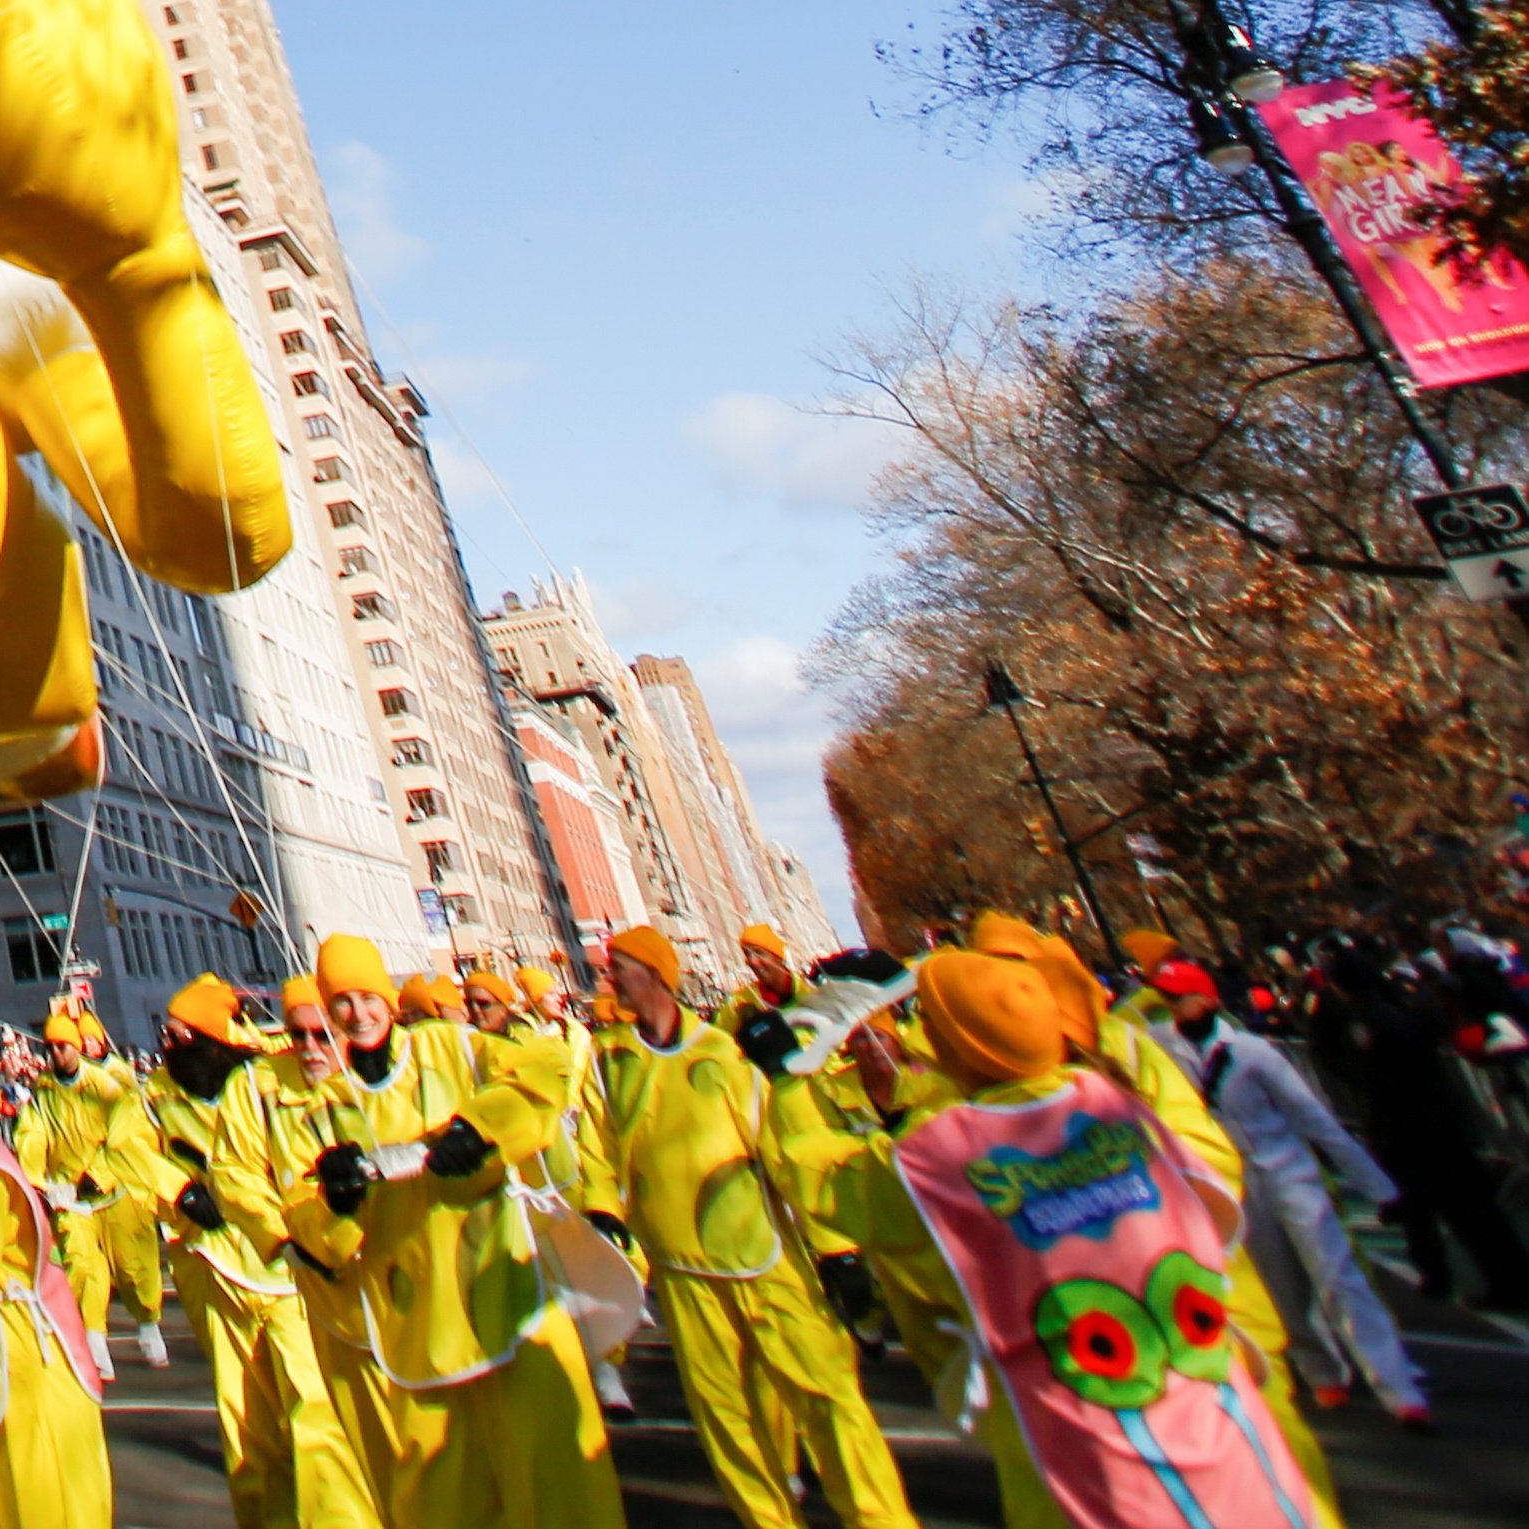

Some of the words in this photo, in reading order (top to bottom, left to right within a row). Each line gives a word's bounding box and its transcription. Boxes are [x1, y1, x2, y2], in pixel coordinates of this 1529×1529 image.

[1294, 96, 1378, 127] NYC
[1334, 168, 1434, 215] MEAN
[1349, 201, 1431, 243] GIR
[1446, 335, 1469, 347] ON
